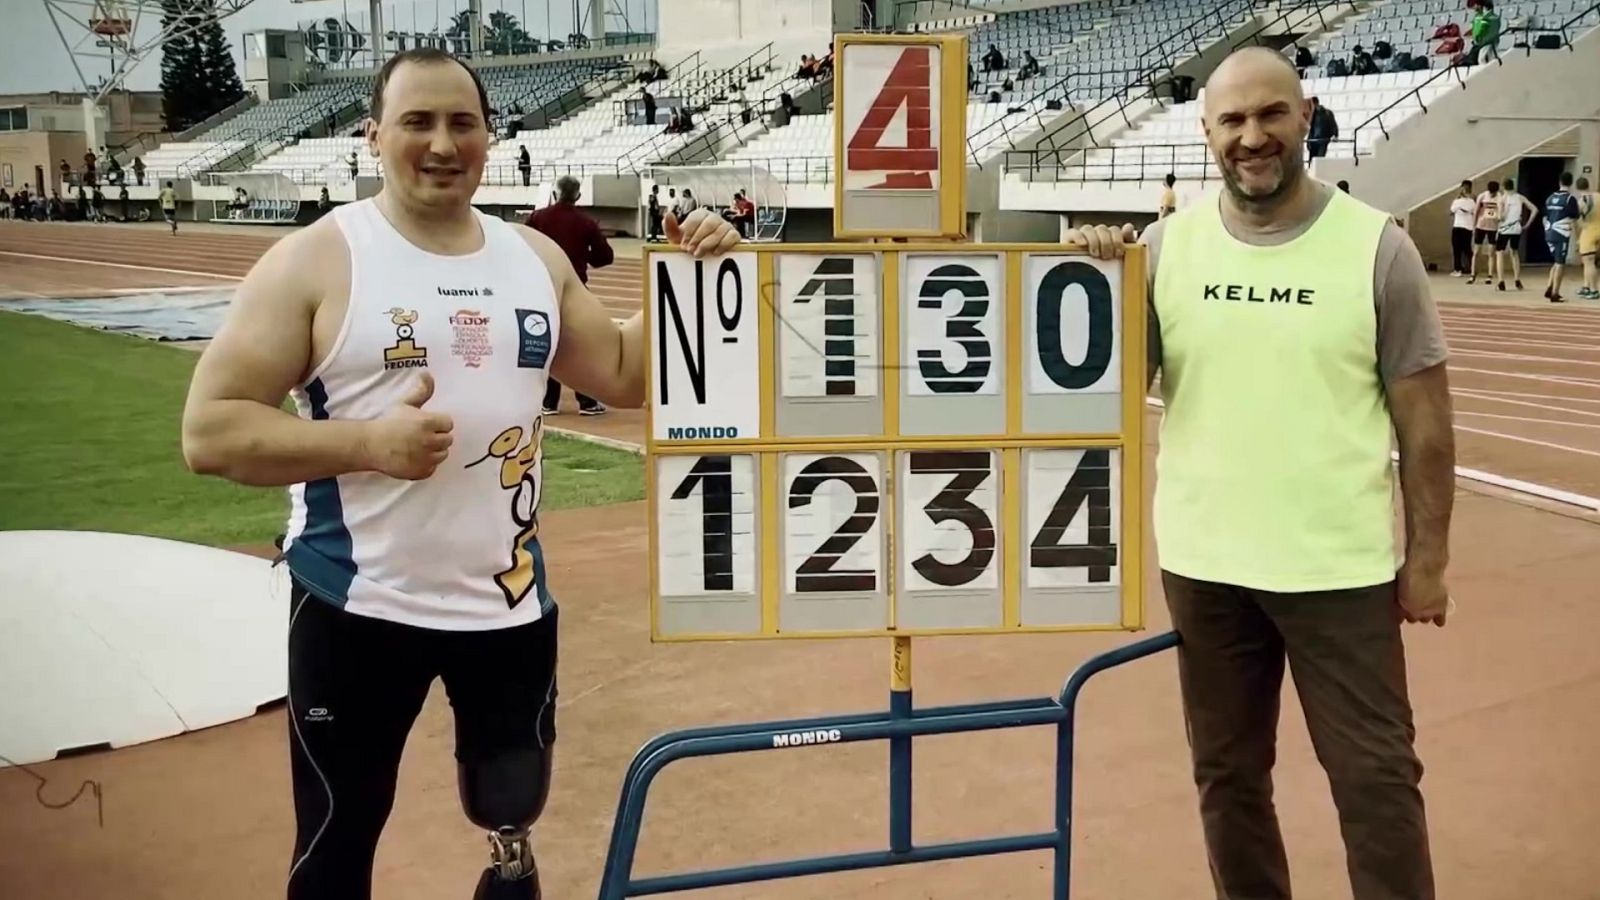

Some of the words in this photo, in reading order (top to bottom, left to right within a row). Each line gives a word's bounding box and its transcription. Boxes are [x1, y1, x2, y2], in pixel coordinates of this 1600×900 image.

[847, 47, 939, 188] 4
[437, 286, 479, 297] luanvi
[1204, 284, 1315, 305] KELME
[384, 359, 428, 370] FEDEMA
[668, 426, 738, 439] MONDO
